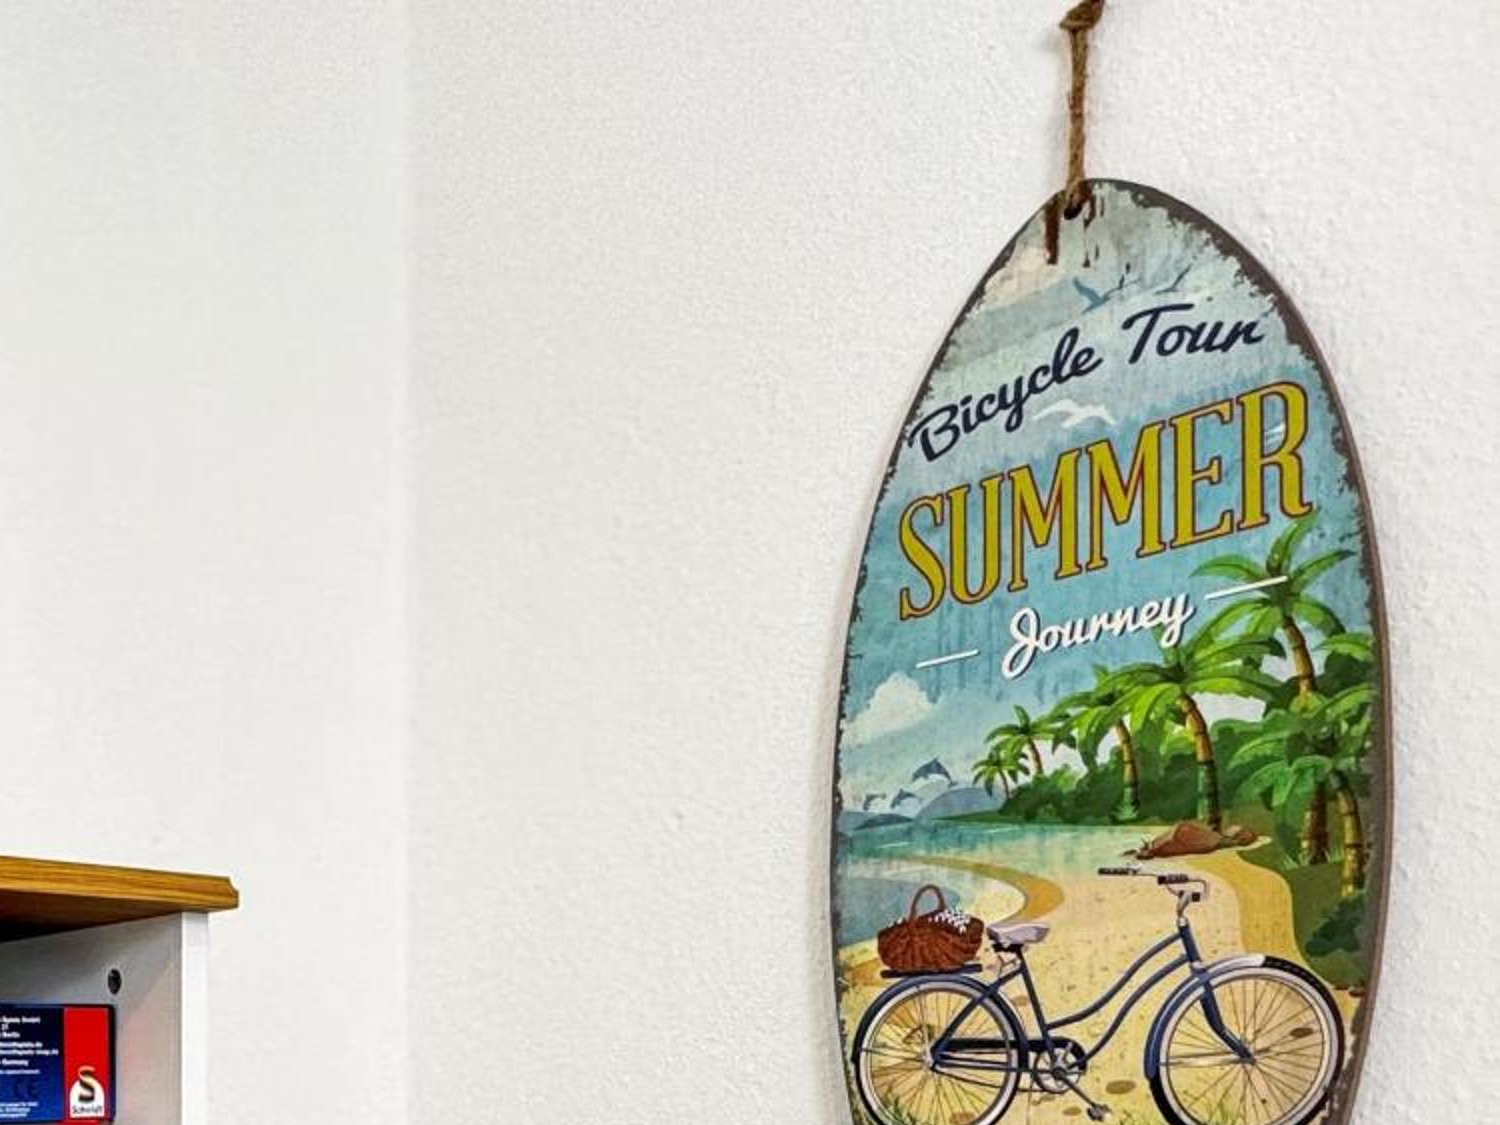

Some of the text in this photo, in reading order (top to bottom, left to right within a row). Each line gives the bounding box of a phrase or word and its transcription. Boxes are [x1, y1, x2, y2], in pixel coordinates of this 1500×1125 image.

[906, 302, 1265, 463] Bicycle Tour
[899, 378, 1313, 620] SUMMER
[1001, 592, 1195, 680] Journey
